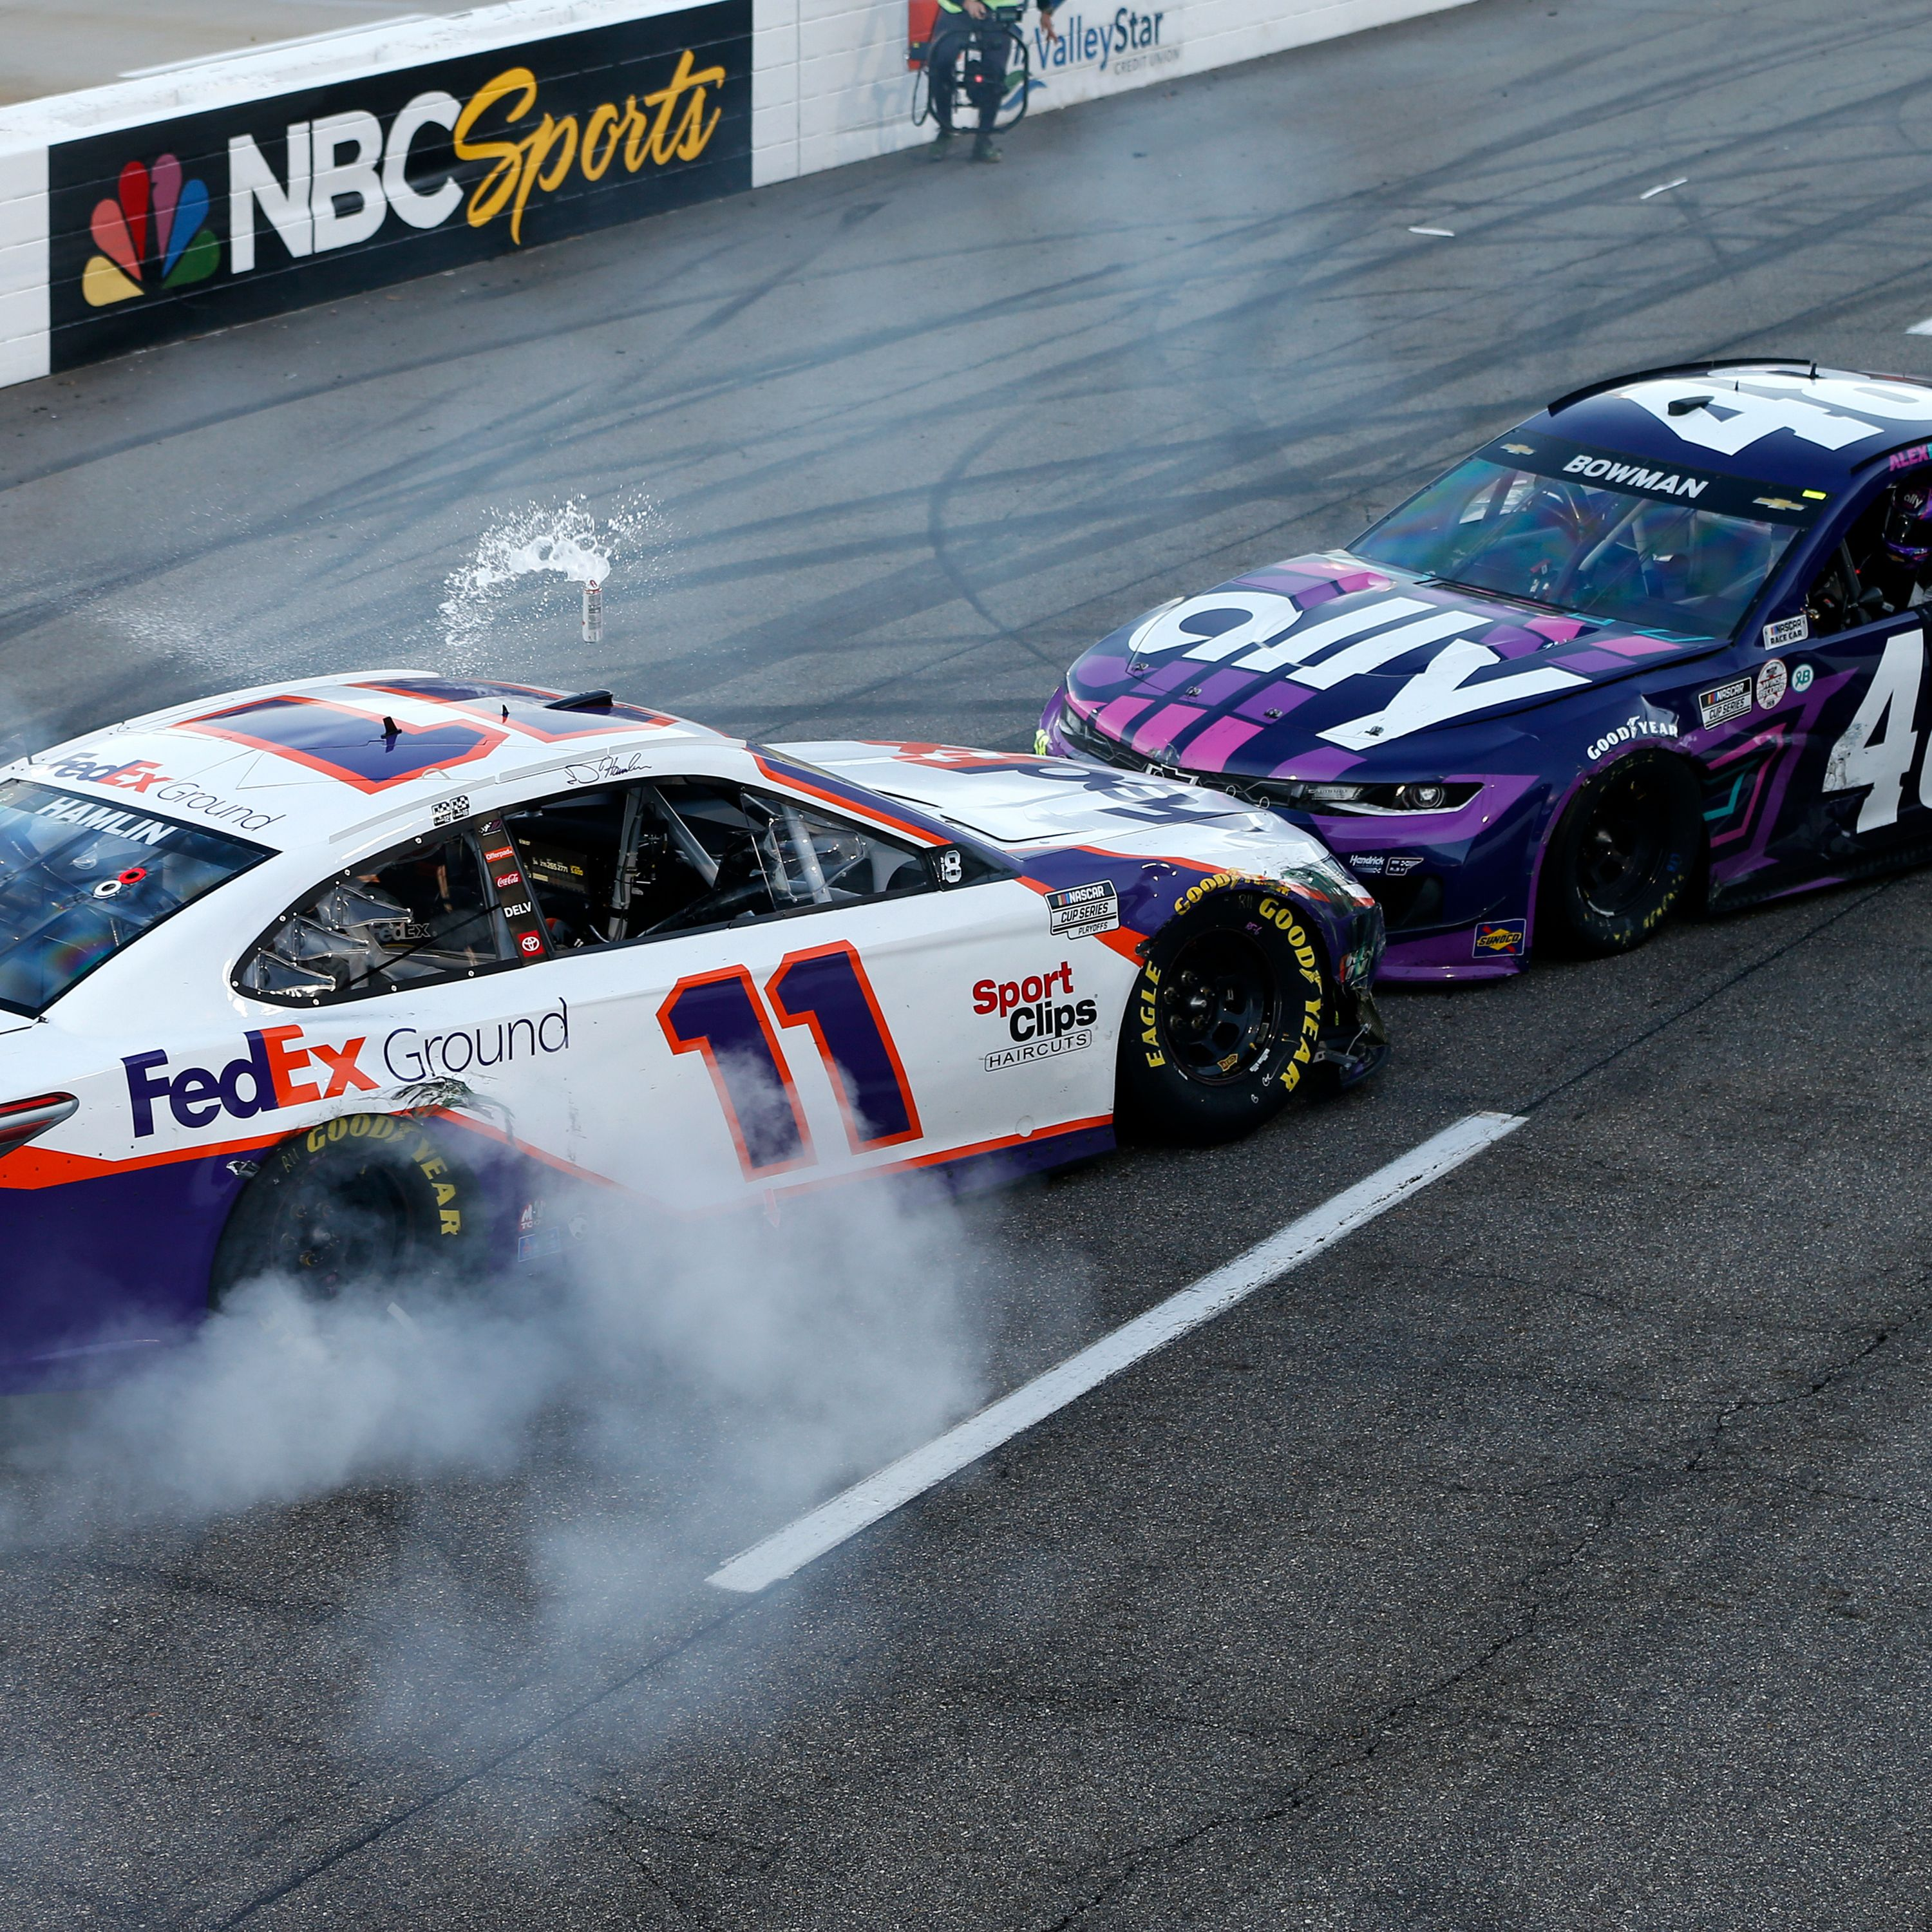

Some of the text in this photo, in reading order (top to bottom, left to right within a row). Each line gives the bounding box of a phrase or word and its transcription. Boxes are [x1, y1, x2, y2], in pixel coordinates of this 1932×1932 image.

[1034, 7, 1164, 71] ValleyStar
[1114, 55, 1147, 75] CREDIT
[228, 50, 726, 274] NBC Sports
[1889, 443, 1929, 471] ALEX
[1563, 455, 1709, 499] BOWMAN
[1904, 493, 1924, 509] ally
[1770, 630, 1803, 644] RACE CAR
[1777, 620, 1802, 634] NASCAR
[1128, 592, 1593, 752] ally
[1709, 698, 1745, 720] CUP SERIES
[1716, 683, 1745, 702] NASCAR
[1821, 629, 1932, 834] 4
[35, 797, 180, 846] HAMLIN
[156, 782, 287, 831] Ground
[1349, 855, 1385, 866] Hendrick
[1068, 885, 1105, 904] NASCAR
[1061, 902, 1109, 923] CUP SERIES
[1078, 921, 1108, 935] PLAYOFFS
[1479, 933, 1520, 945] SUNOCO
[972, 961, 1074, 1018] Sport
[1009, 999, 1097, 1042] Clips
[1140, 960, 1166, 1068] EAGLE
[120, 996, 570, 1138] FedEx Ground
[656, 939, 924, 1184] 11
[989, 1033, 1087, 1068] HAIRCUTS
